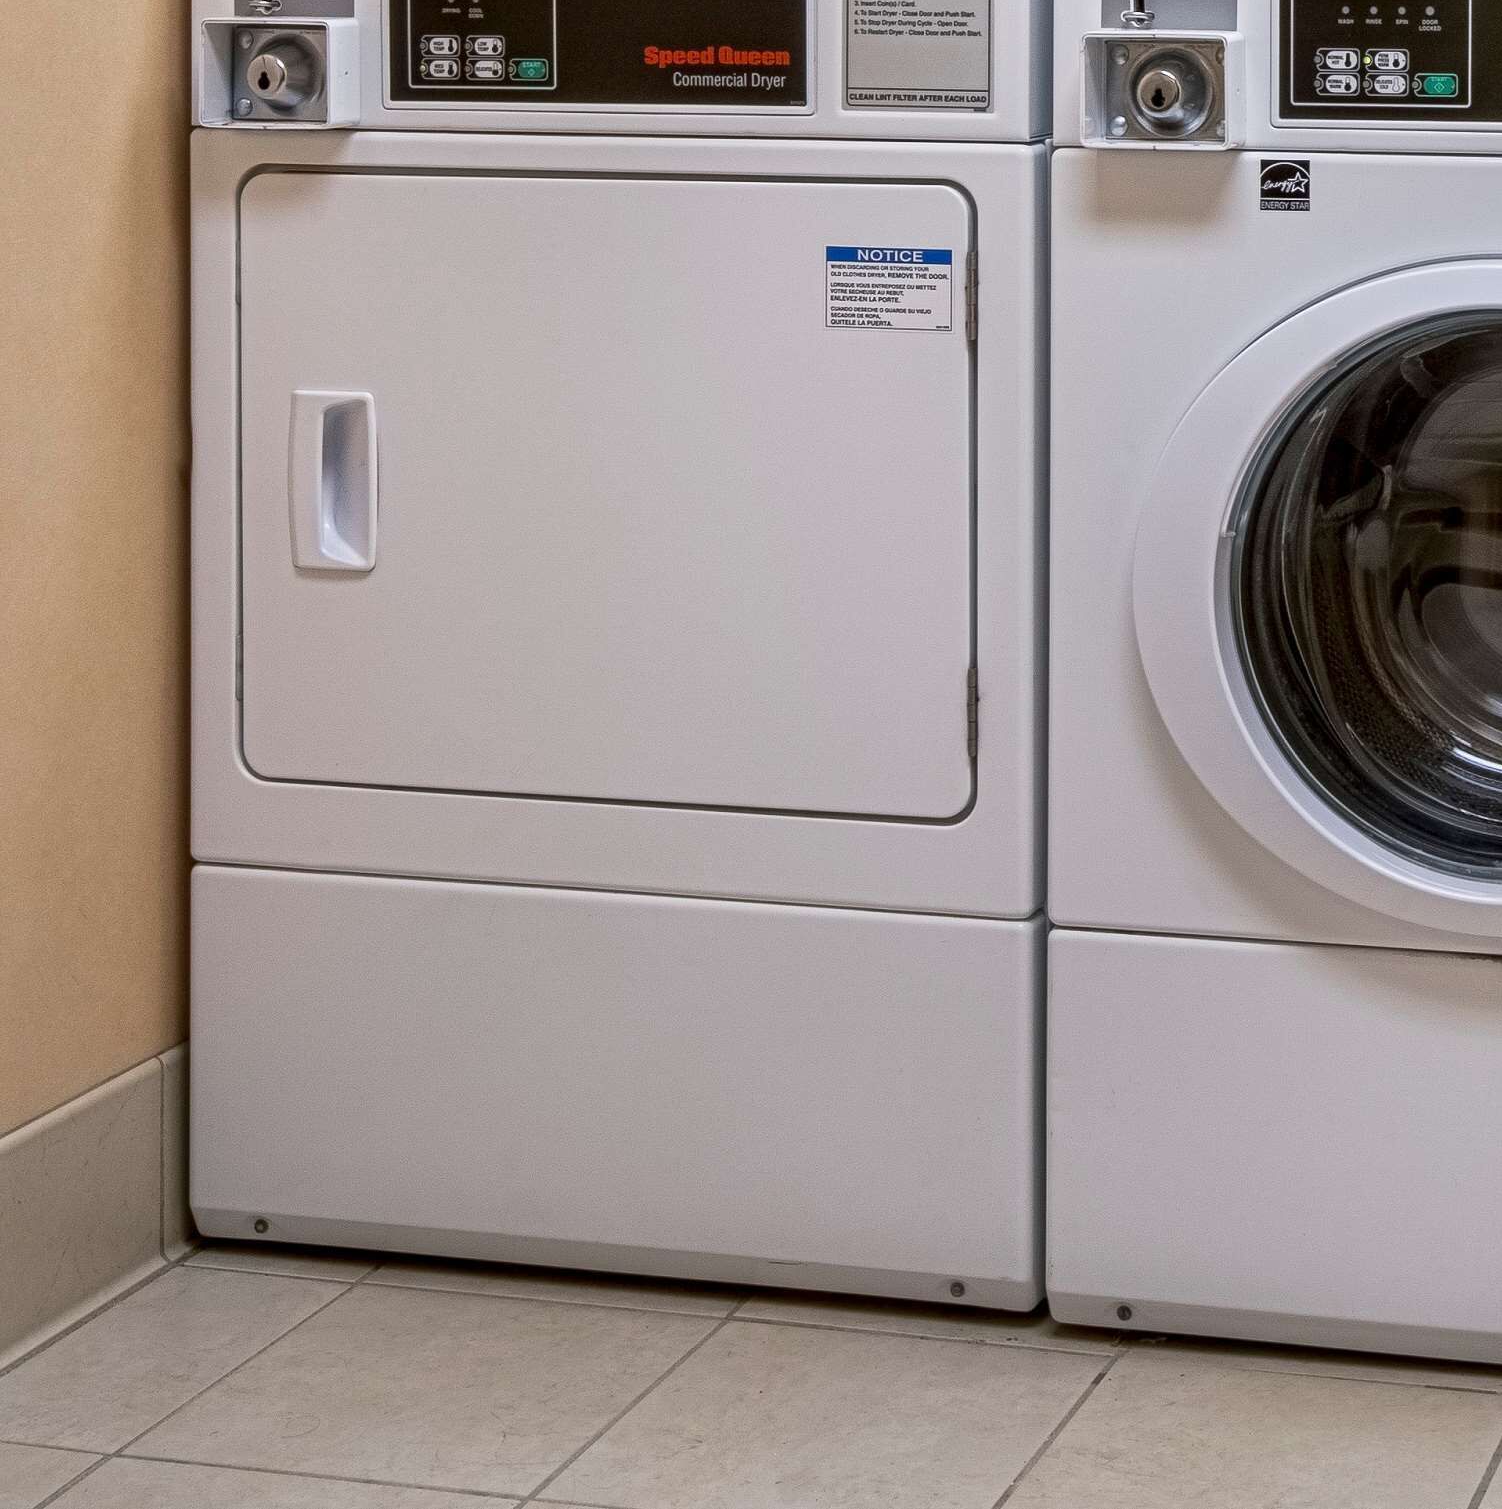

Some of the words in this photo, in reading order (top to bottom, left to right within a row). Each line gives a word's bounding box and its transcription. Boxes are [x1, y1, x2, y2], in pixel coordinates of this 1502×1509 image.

[644, 46, 715, 68] Speed
[719, 46, 790, 65] Queen
[673, 72, 747, 87] Commercial
[752, 73, 786, 90] Dryer
[1261, 201, 1289, 209] ENERGY
[857, 250, 923, 262] NOTICE
